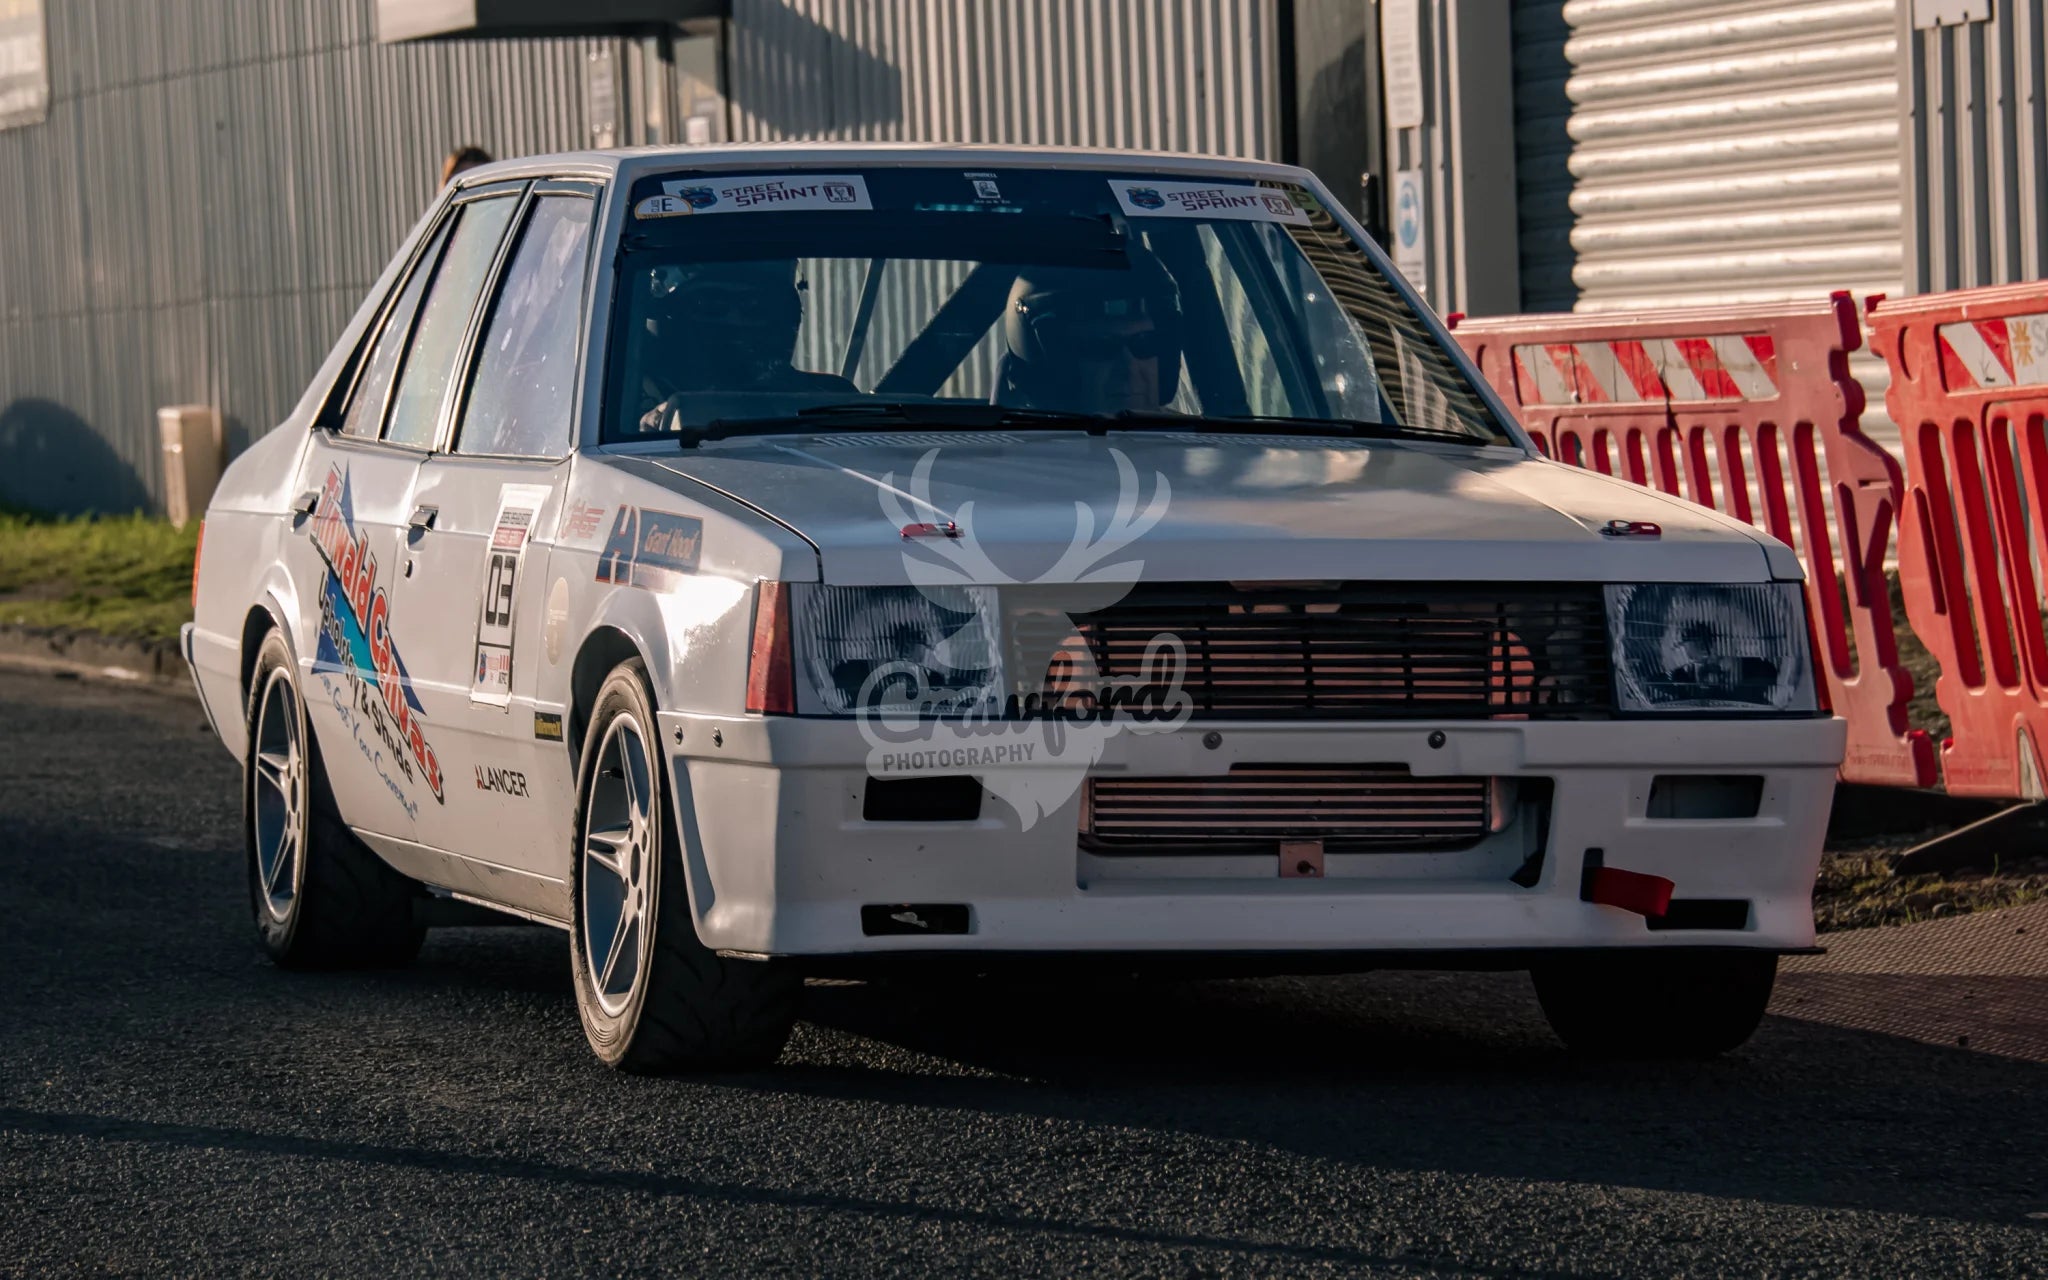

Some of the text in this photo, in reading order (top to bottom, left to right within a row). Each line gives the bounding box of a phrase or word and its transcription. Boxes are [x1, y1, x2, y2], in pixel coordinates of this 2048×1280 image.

[721, 181, 785, 199] STREET
[735, 185, 819, 207] SPRINT
[1167, 189, 1225, 202] STREET
[662, 198, 673, 212] E
[1181, 195, 1259, 212] SPRINT
[486, 554, 516, 626] 03
[369, 587, 445, 804] Canvas
[361, 681, 371, 720] &
[371, 700, 414, 785] Shade
